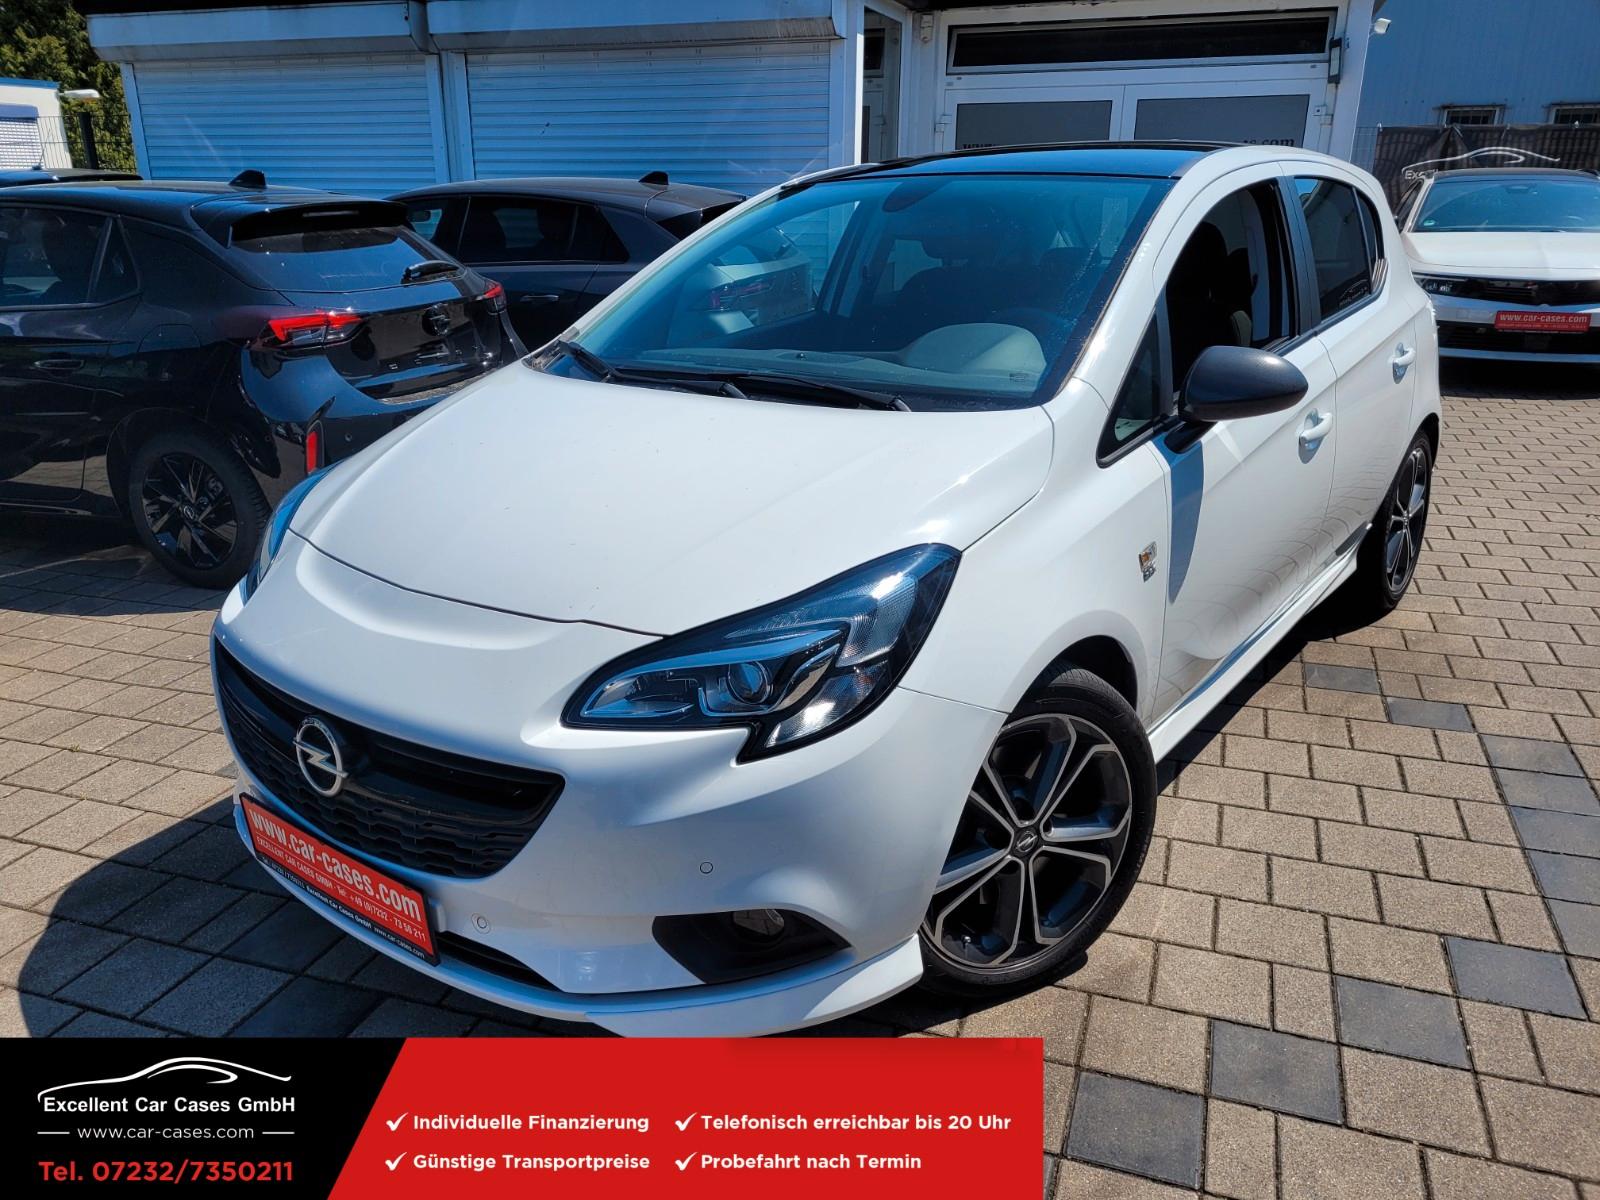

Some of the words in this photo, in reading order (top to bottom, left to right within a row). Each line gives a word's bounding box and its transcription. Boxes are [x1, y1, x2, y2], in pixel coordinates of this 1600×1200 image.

[1500, 313, 1588, 323] www.car-cases.com
[249, 808, 421, 921] www.car-cases.com
[297, 861, 315, 879] CASES
[413, 927, 426, 942] 211
